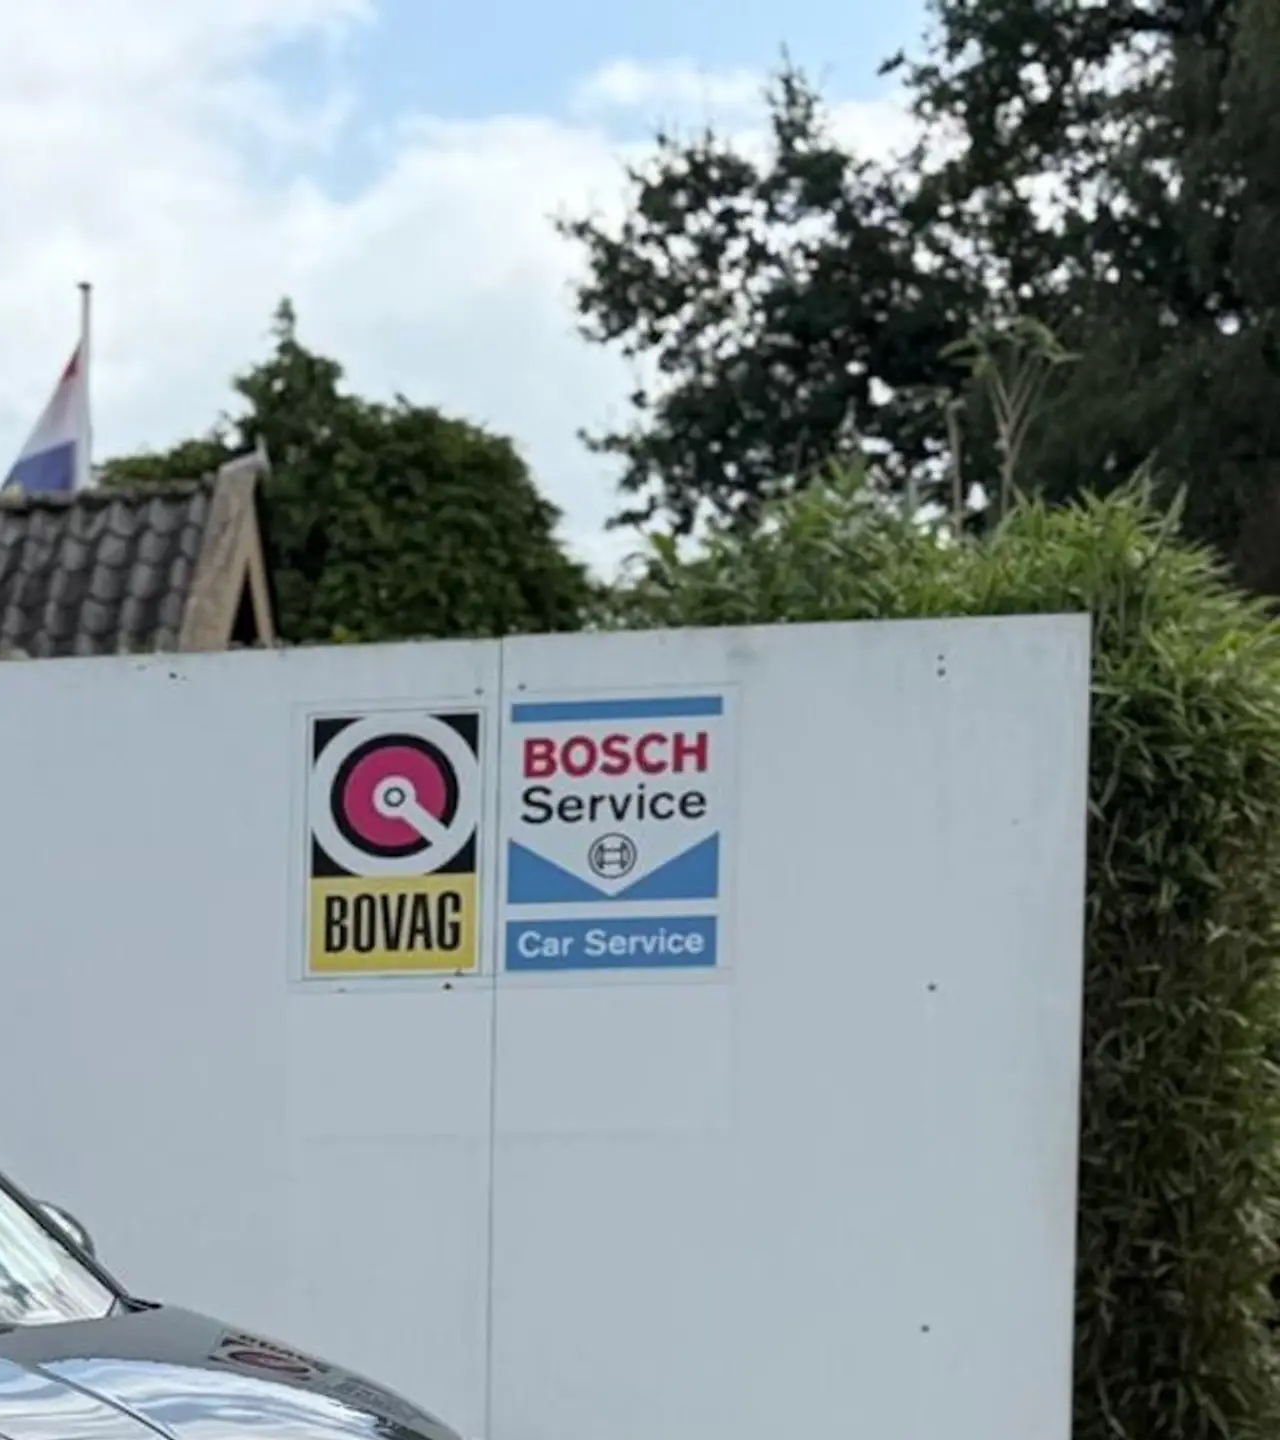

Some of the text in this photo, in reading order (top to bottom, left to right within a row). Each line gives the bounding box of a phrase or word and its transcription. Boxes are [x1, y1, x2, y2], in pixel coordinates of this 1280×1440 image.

[523, 731, 708, 779] BOSCH
[520, 783, 707, 825] Service
[324, 890, 462, 954] BOVAG
[517, 926, 705, 958] Car Service
